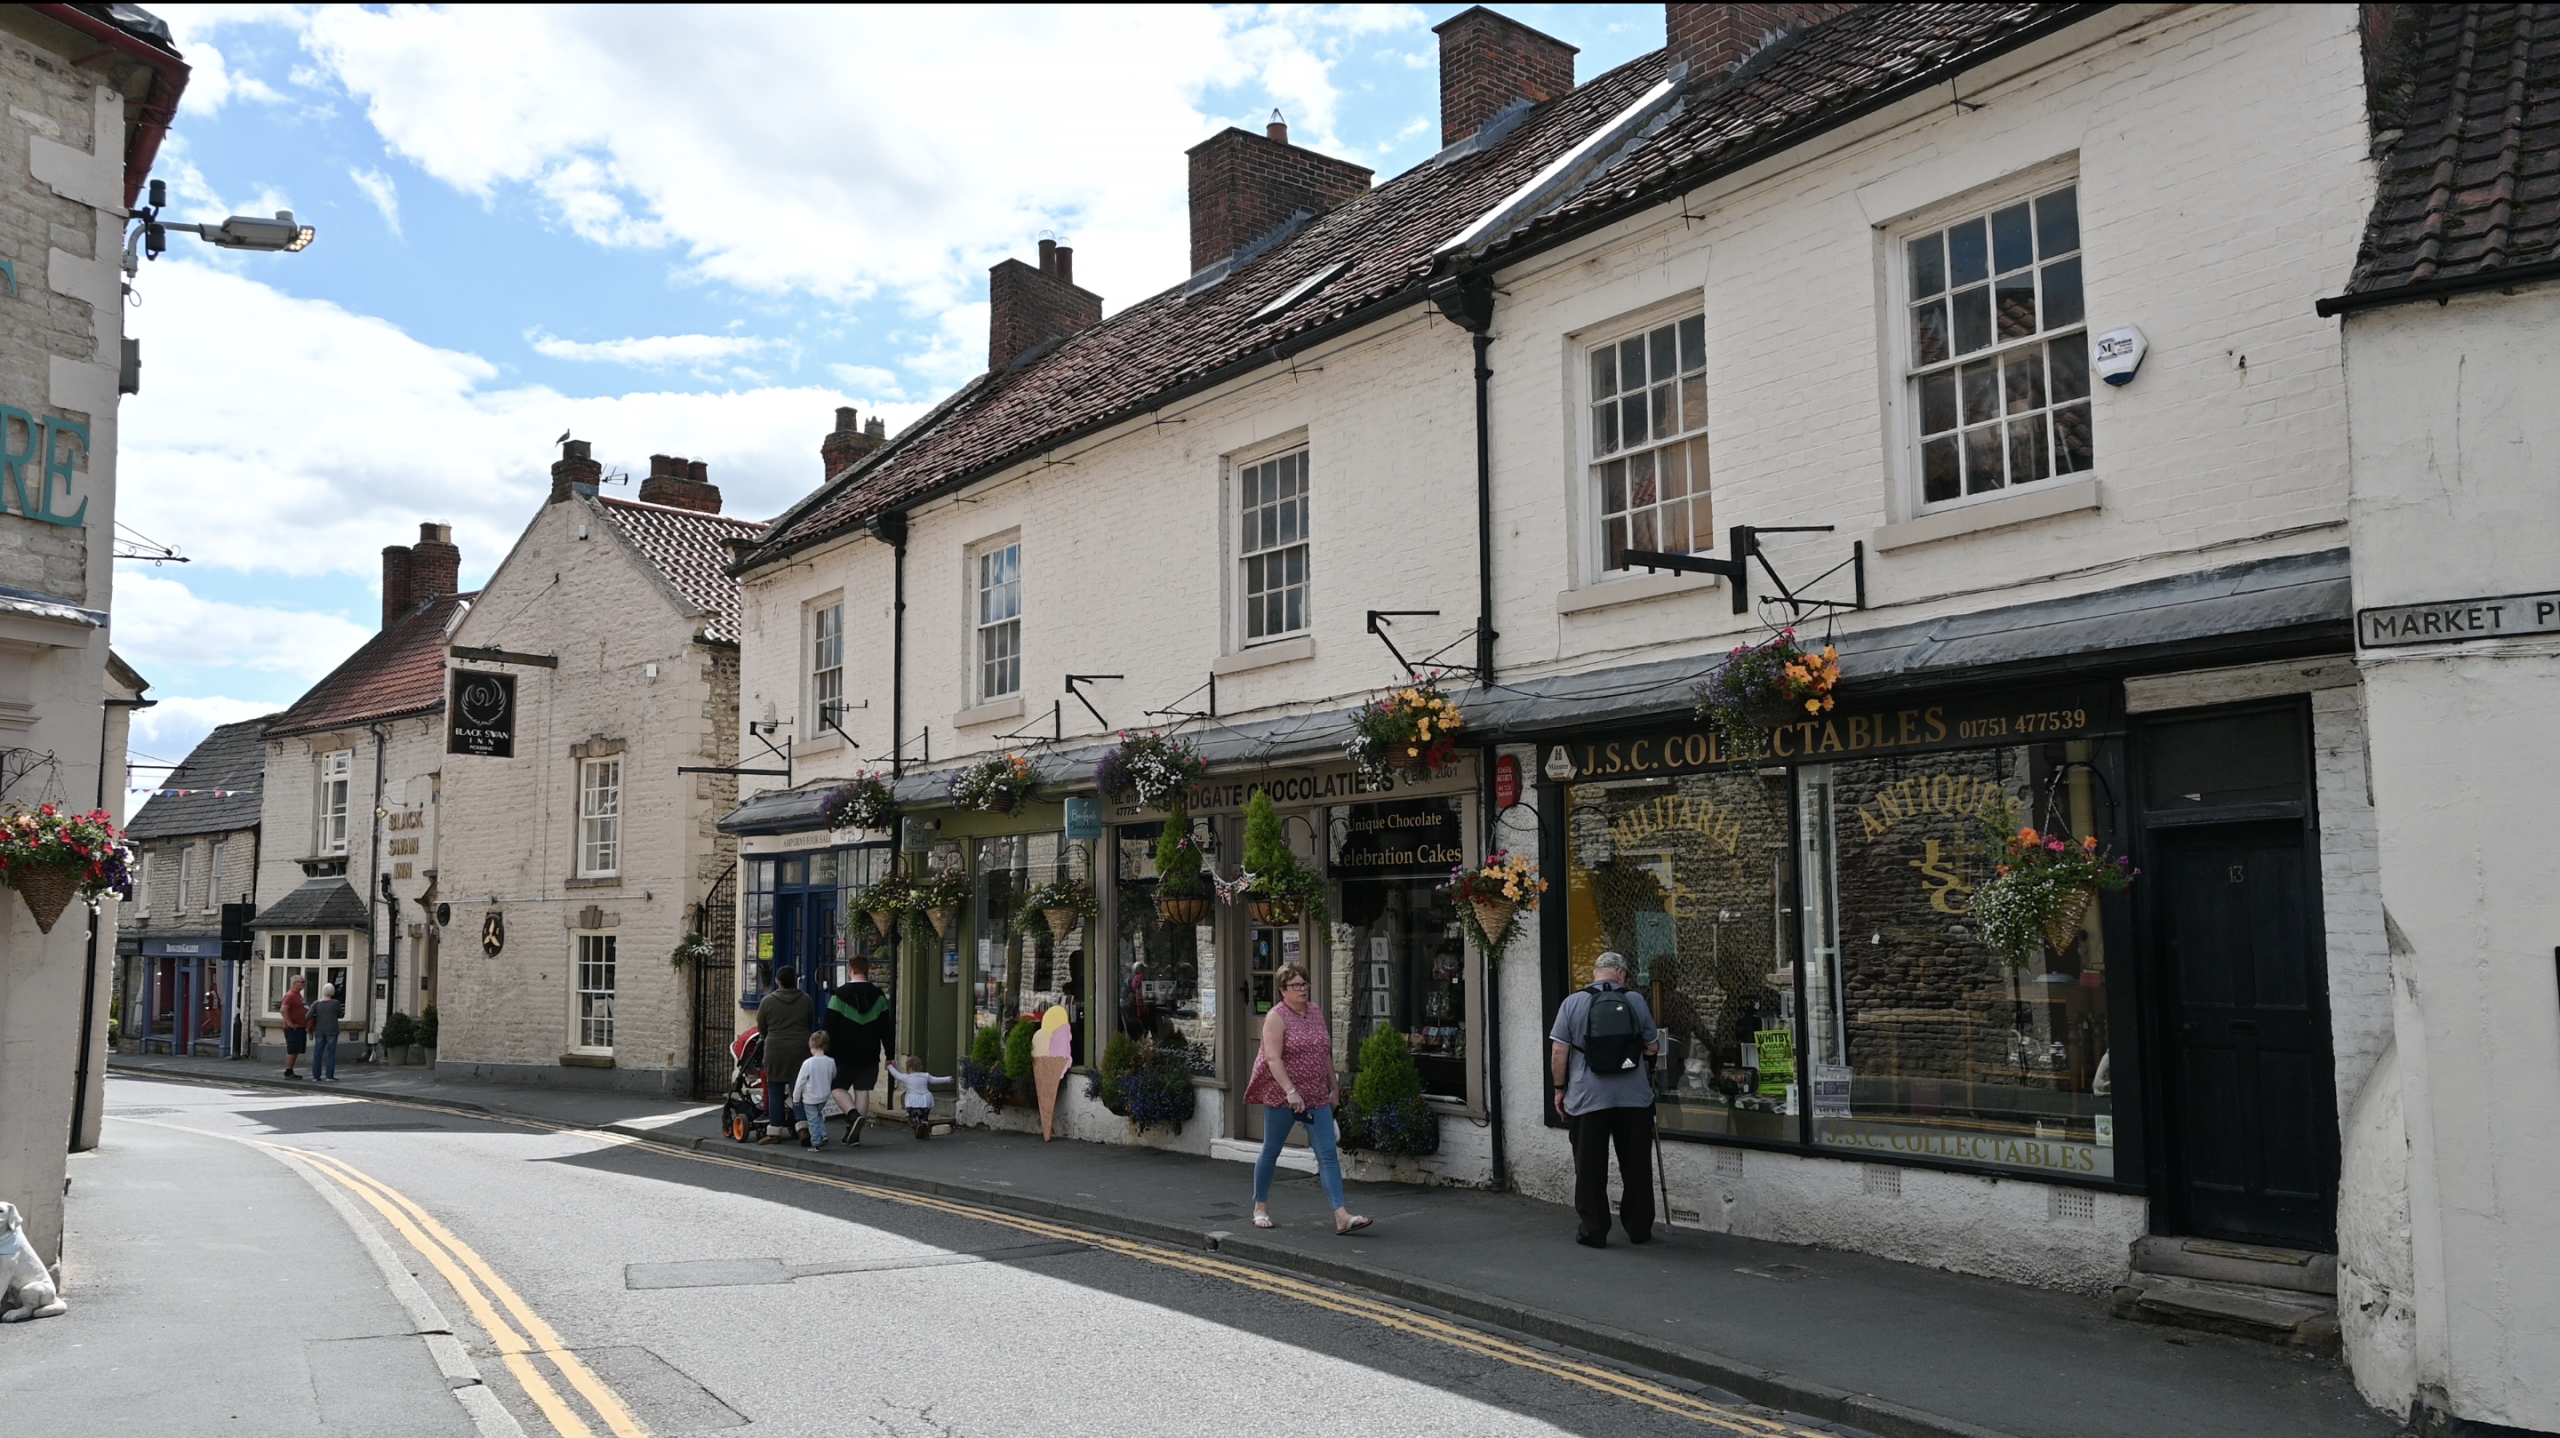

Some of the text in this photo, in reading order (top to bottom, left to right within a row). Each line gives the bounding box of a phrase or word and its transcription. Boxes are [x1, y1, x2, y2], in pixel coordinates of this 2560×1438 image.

[2373, 606, 2503, 639] MARKET
[455, 727, 509, 739] BLACK SWAN
[469, 737, 494, 746] INN
[1582, 739, 1659, 777] J.S.C.
[1959, 716, 2008, 739] 01751
[2015, 708, 2087, 733] 477539
[1164, 782, 1243, 812] RDGATE
[1435, 766, 1458, 779] 2001
[388, 811, 424, 831] BLACK
[1347, 811, 1442, 834] Unique Chocolate
[1609, 794, 1741, 855] MILITARIA
[388, 836, 419, 856] SWAN
[1334, 844, 1462, 868] Celebration Cakes
[393, 862, 412, 879] INN
[2228, 865, 2244, 883] 13
[1756, 1033, 1789, 1043] WHITBY
[1826, 1123, 2095, 1172] J.S.C. COLLECTABLES
